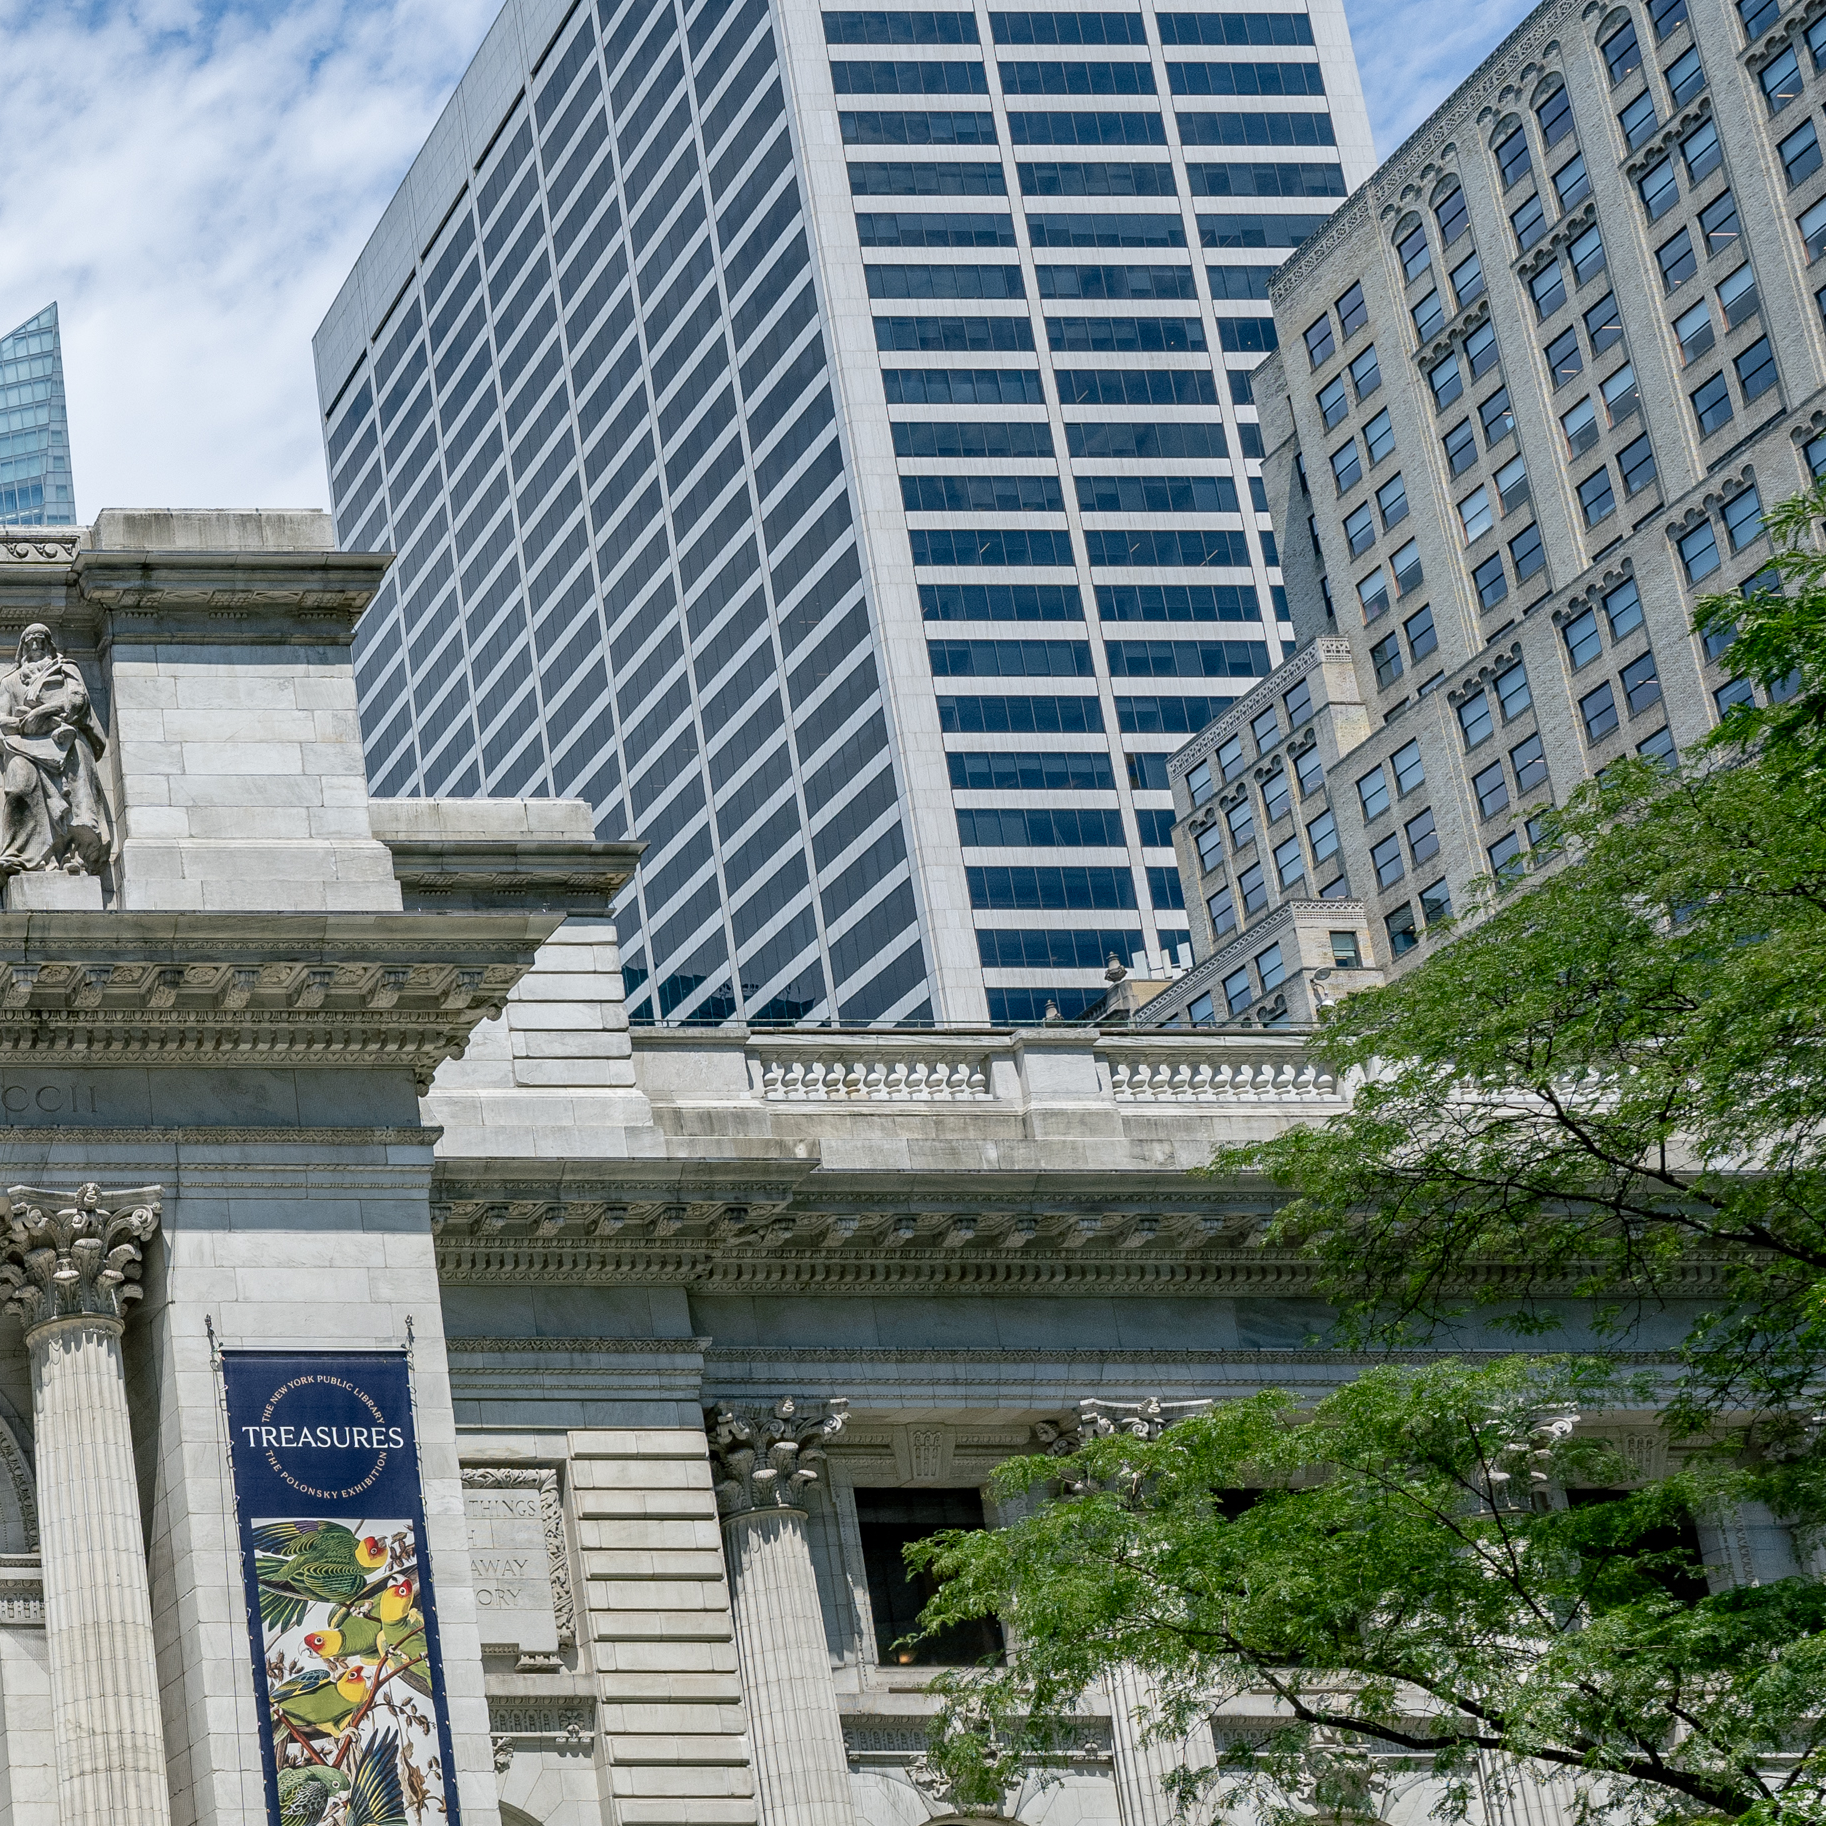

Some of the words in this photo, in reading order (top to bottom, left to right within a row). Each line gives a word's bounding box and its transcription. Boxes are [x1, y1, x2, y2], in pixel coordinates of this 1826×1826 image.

[261, 1403, 275, 1423] THE
[270, 1385, 289, 1405] NEW
[287, 1375, 315, 1389] YORK
[317, 1375, 354, 1391] PUBLIC
[353, 1387, 386, 1424] LIBRARY
[242, 1426, 404, 1449] TREASURES
[265, 1450, 283, 1472] THE
[280, 1471, 338, 1499] POLONSKY
[341, 1451, 388, 1498] EXHIBITION
[469, 1500, 537, 1517] THINGS
[471, 1559, 528, 1577] AWAY
[476, 1588, 522, 1606] ORY
